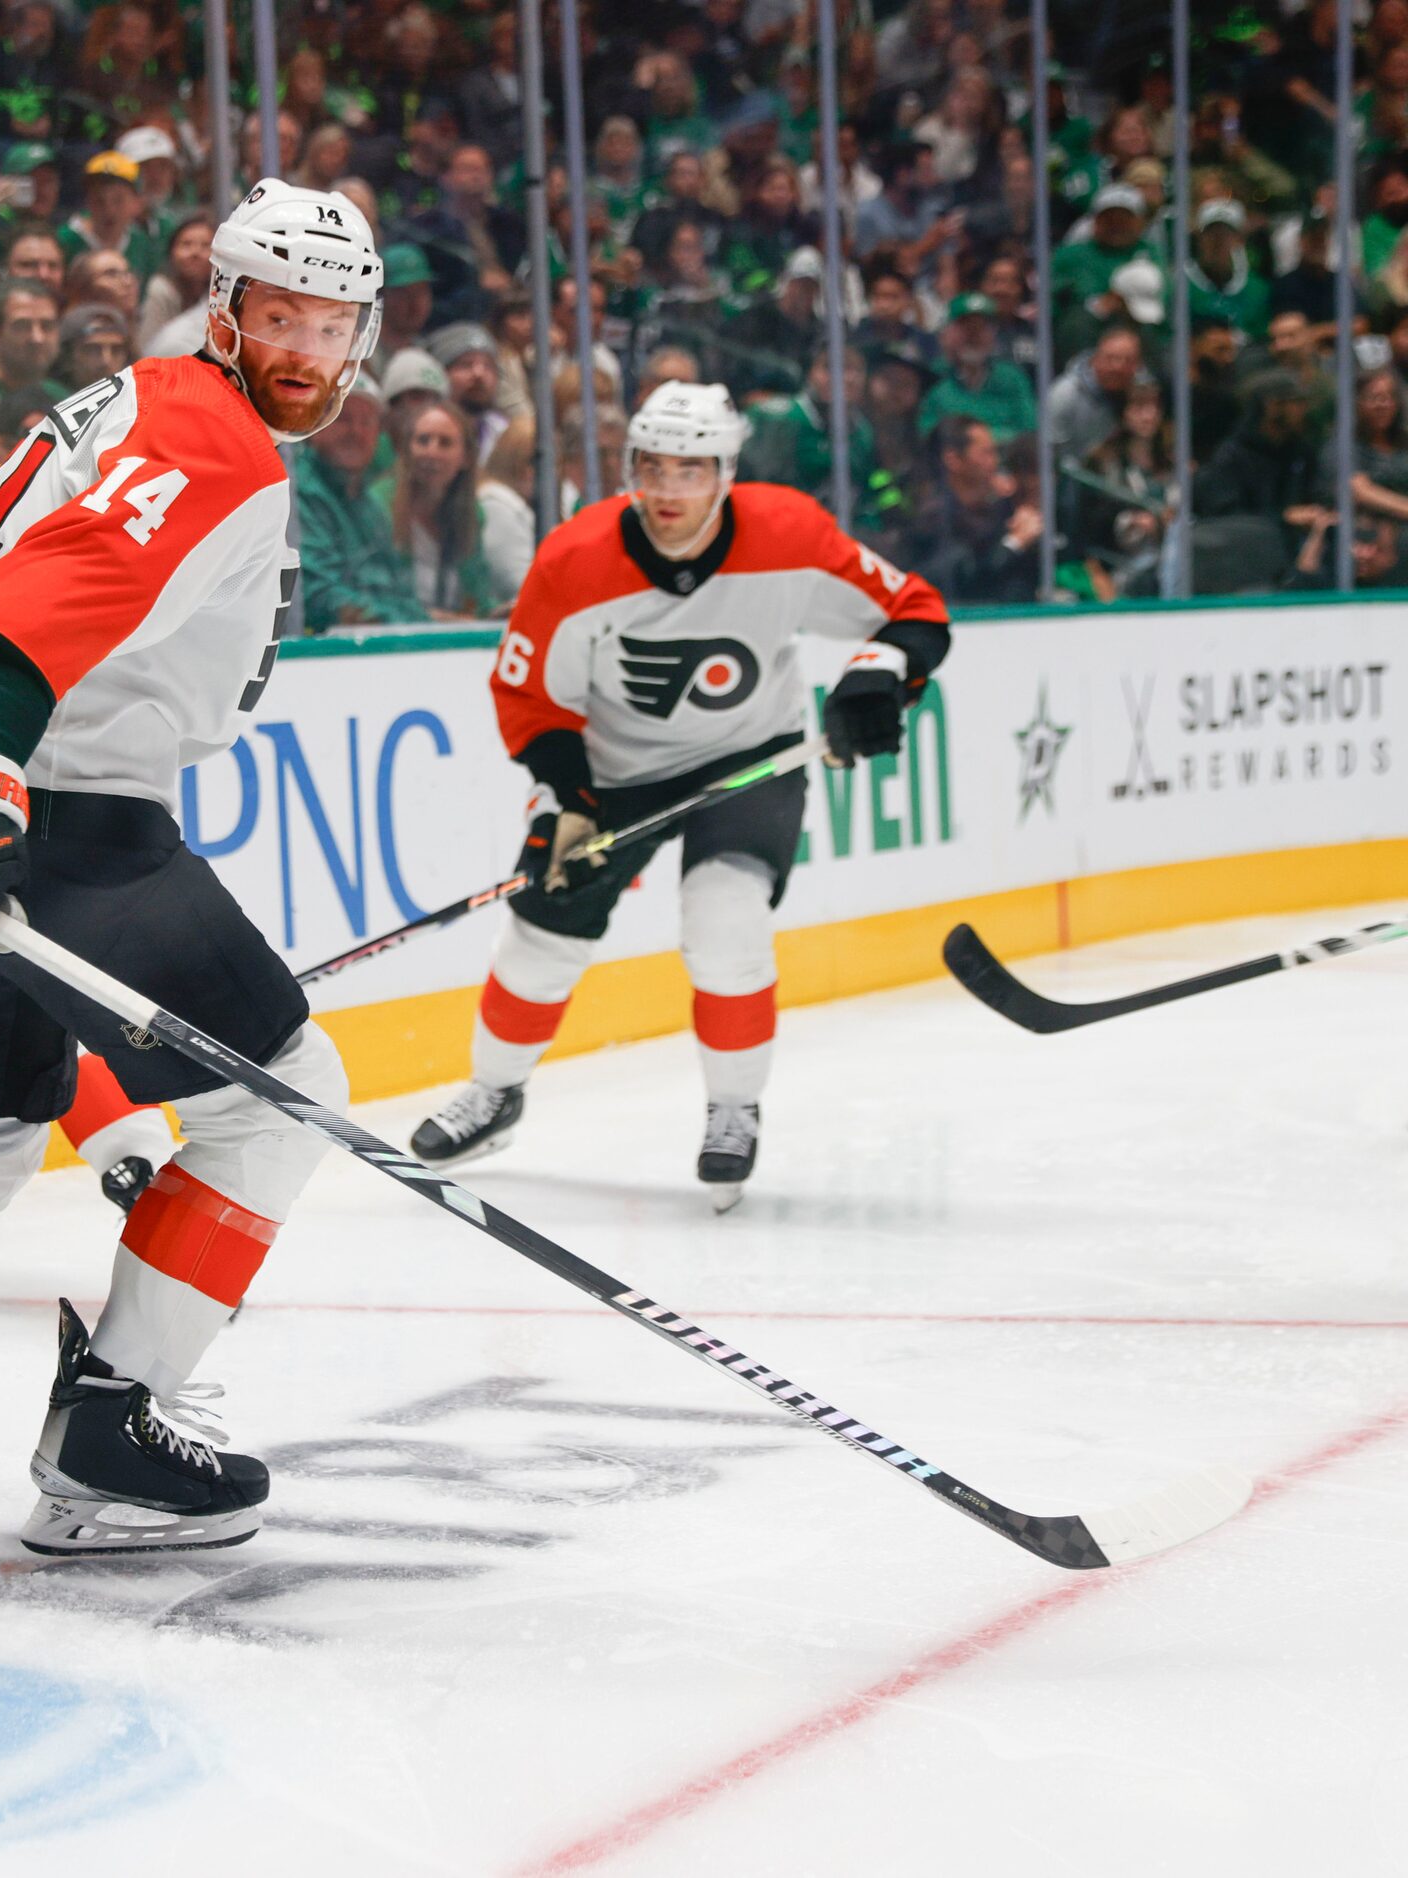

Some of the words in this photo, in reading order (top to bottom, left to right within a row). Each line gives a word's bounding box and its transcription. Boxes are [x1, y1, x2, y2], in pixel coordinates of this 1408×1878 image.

[315, 205, 344, 227] 14
[303, 256, 354, 273] CCM
[79, 455, 191, 547] 14
[496, 631, 536, 688] 6
[1179, 662, 1389, 733] SLAPSHOT
[1179, 738, 1392, 792] REWARDS
[181, 709, 454, 949] PNC
[612, 1290, 942, 1482] WARRIOR
